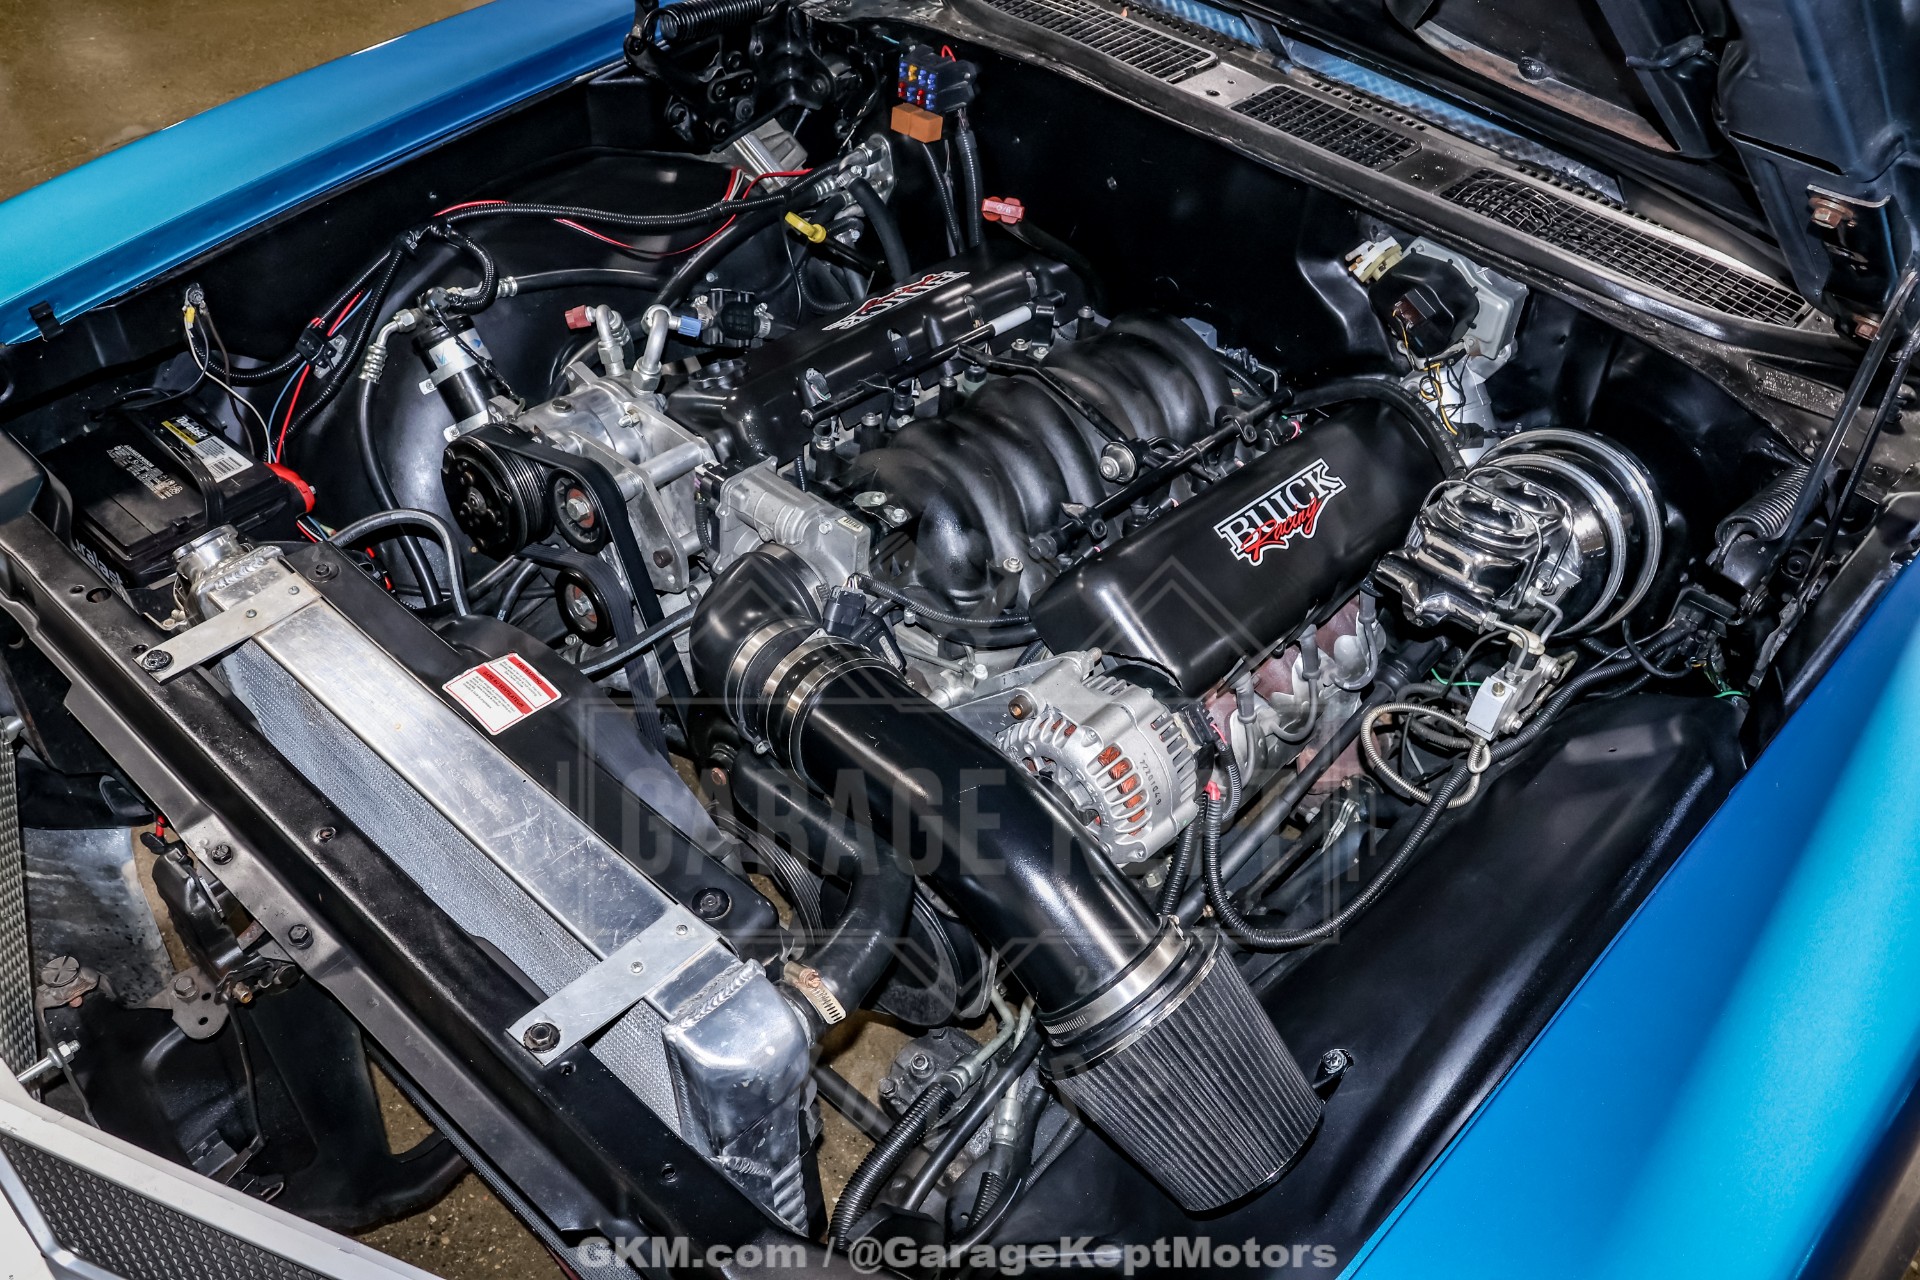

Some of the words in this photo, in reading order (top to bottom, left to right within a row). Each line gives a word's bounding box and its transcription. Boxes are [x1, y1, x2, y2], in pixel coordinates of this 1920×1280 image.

[1220, 464, 1341, 554] BUICK
[1240, 497, 1322, 561] Racing
[75, 538, 123, 584] ralast
